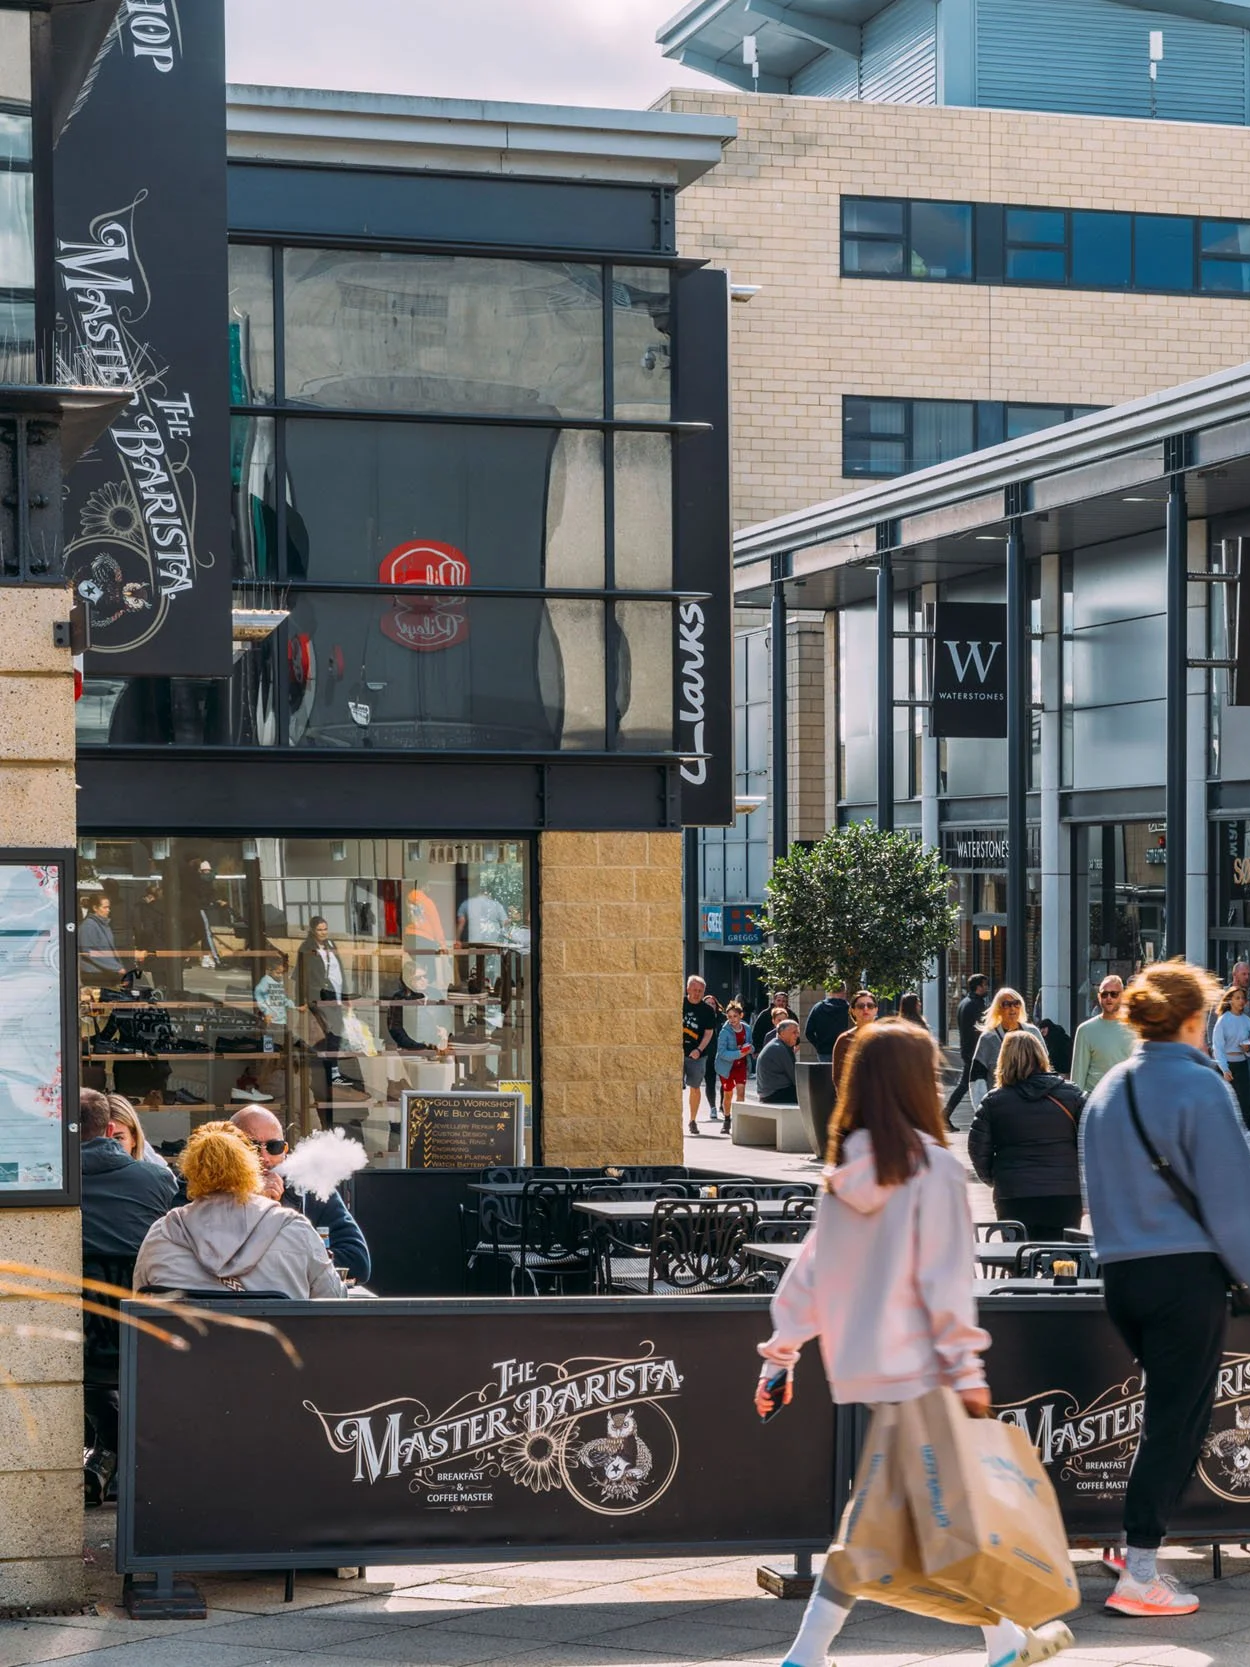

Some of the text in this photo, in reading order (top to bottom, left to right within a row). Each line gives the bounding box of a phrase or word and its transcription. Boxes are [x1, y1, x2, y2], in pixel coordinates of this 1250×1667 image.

[55, 221, 193, 600] MASTE BARISTA
[150, 392, 195, 439] THE
[943, 640, 1002, 683] W
[679, 603, 707, 785] Clarks
[939, 692, 1004, 701] WATERSTONES
[957, 840, 1009, 858] WATERSTONES
[728, 934, 759, 942] GREGGS
[433, 1099, 515, 1108] GOLD WORKSHOP
[433, 1109, 449, 1117] WE
[473, 1110, 500, 1118] GOLD
[492, 1357, 537, 1397] THE
[335, 1357, 684, 1485] MASTER BARISTA
[996, 1399, 1145, 1466] MASTER
[1085, 1461, 1127, 1470] BREAKFAST
[437, 1472, 484, 1481] BREAKFAST
[1102, 1471, 1109, 1479] &
[456, 1482, 464, 1492] &
[1076, 1480, 1128, 1490] COFFEE MAST
[427, 1492, 493, 1502] COFFEE MASTER
